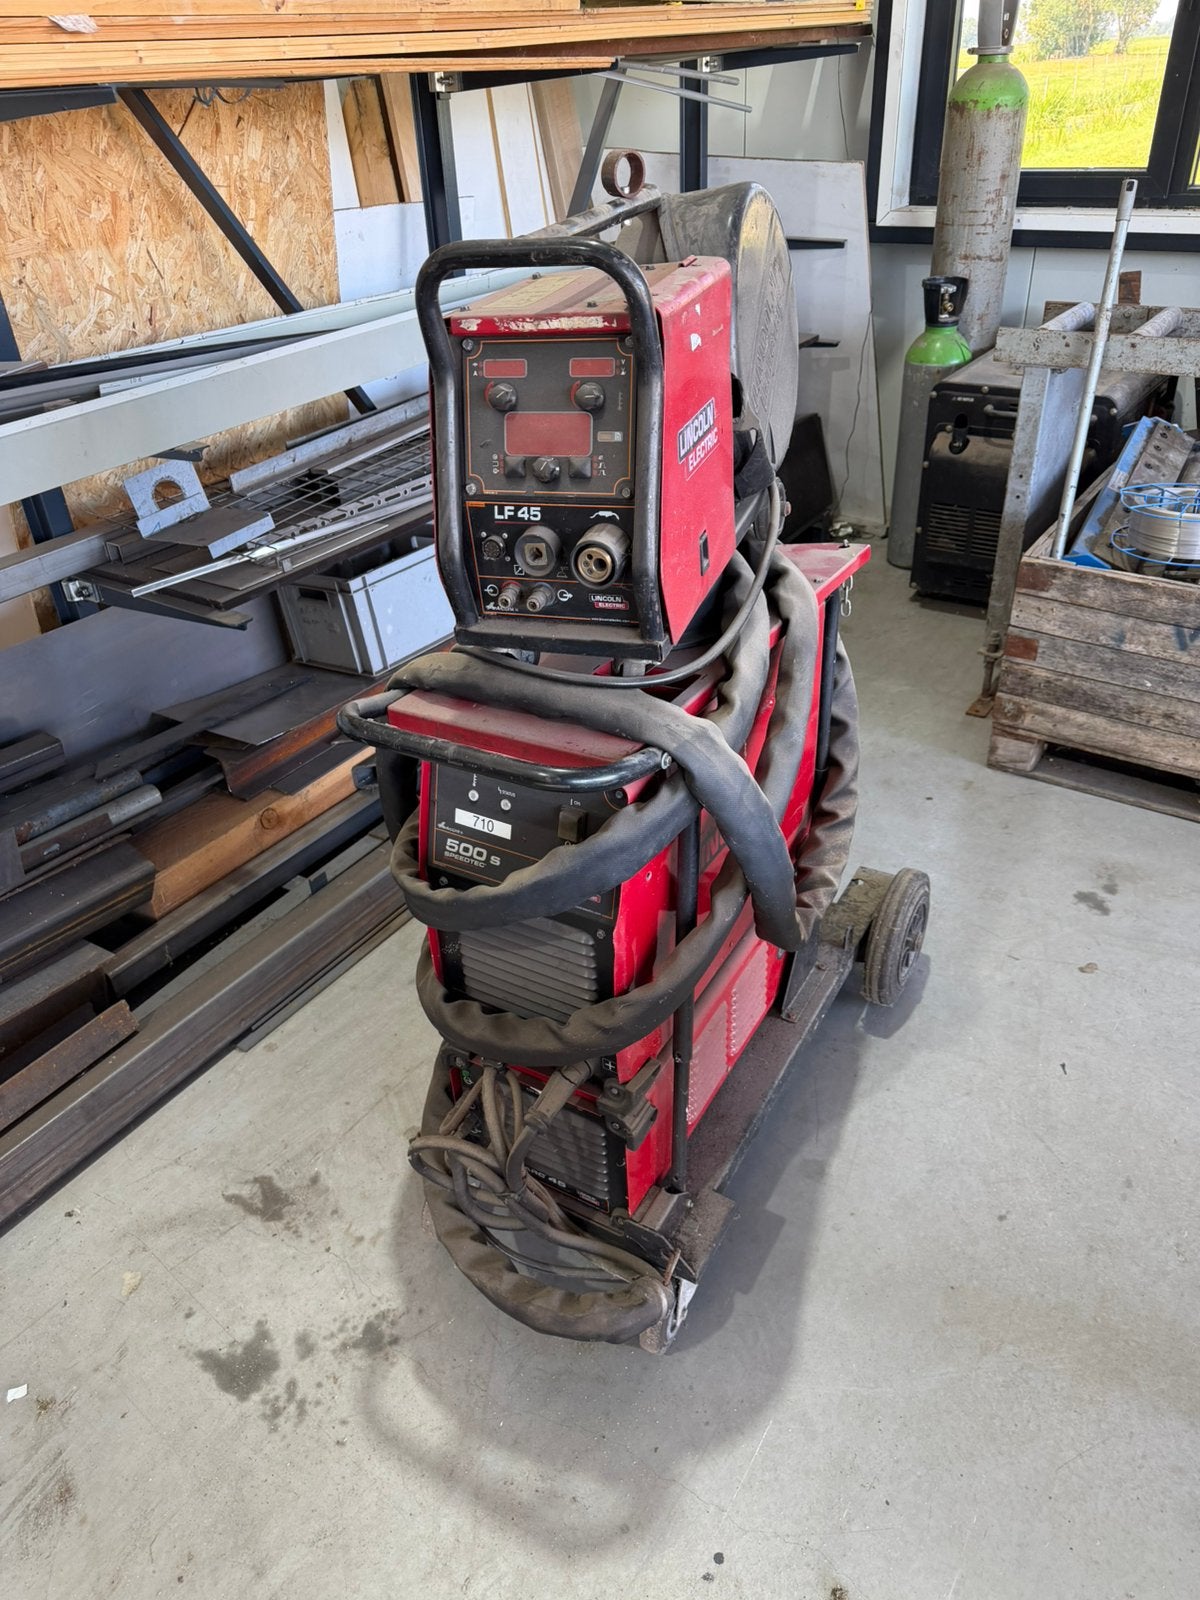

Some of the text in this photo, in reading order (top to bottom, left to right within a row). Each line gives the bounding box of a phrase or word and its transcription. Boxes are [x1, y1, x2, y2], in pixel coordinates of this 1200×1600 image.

[680, 401, 714, 458] LINCOLN
[688, 427, 719, 472] ELECTRIC
[494, 505, 541, 521] LF 45
[590, 594, 622, 602] LINCOLN
[472, 815, 495, 833] 710
[445, 838, 487, 861] 500
[444, 850, 486, 868] SPEEDTEC
